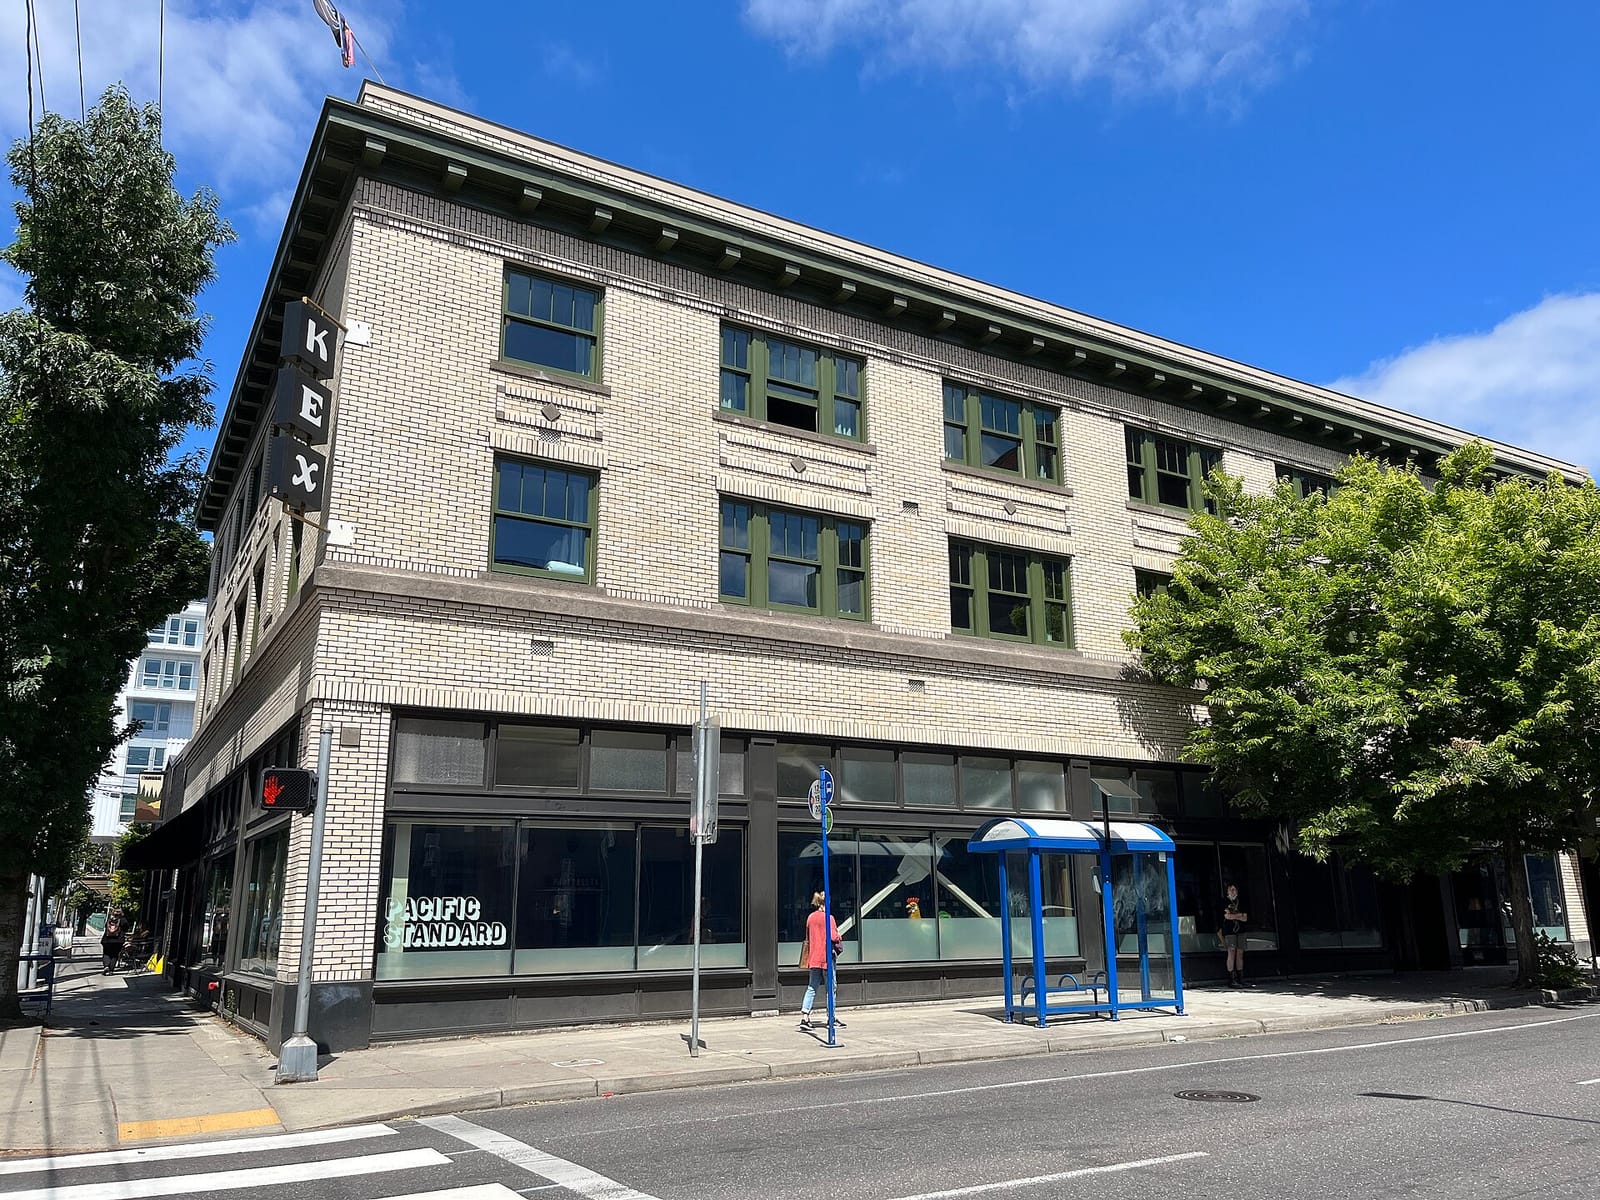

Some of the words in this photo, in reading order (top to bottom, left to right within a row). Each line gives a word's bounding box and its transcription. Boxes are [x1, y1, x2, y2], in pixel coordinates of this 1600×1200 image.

[292, 318, 329, 493] KEX
[385, 896, 481, 922] PACIFIC
[383, 921, 507, 948] STANDARD
